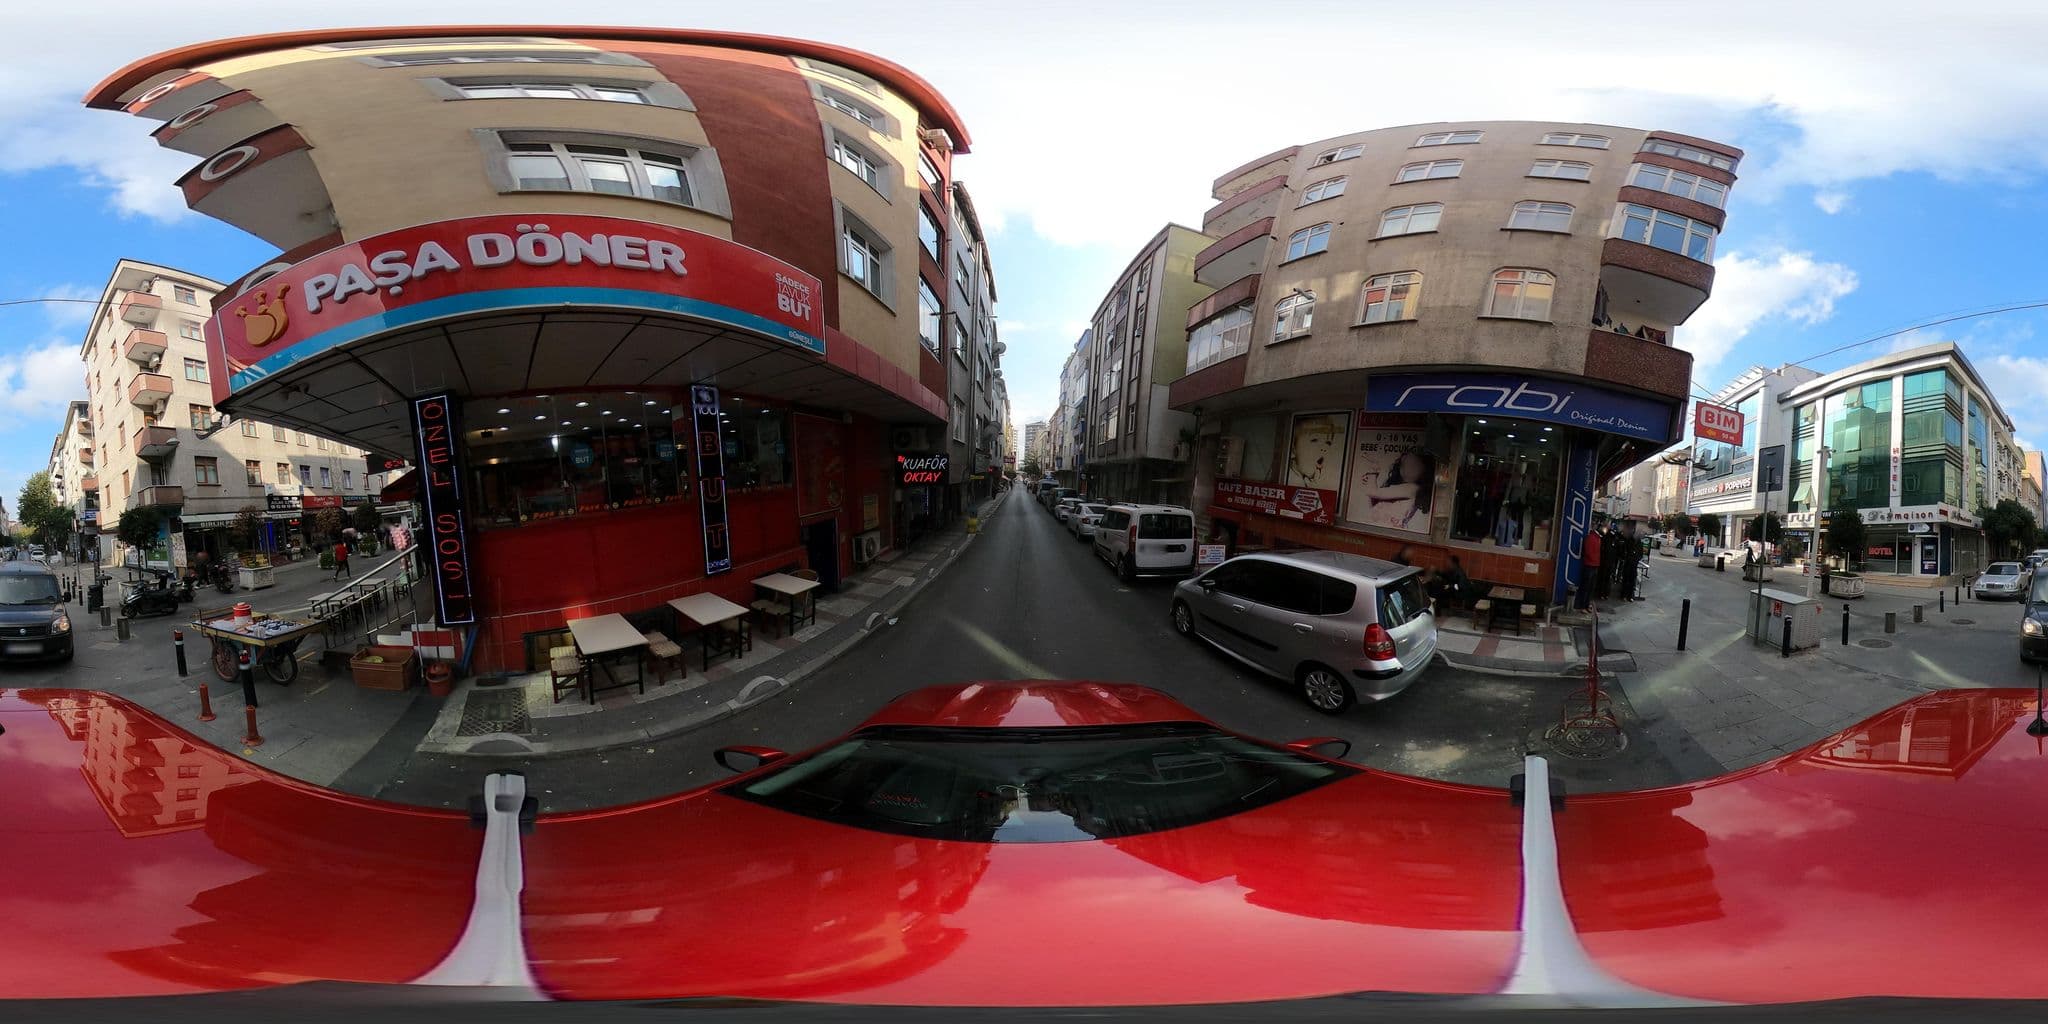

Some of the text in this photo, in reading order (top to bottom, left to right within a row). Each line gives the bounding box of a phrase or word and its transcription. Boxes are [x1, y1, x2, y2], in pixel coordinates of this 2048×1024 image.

[303, 223, 688, 313] PAŞA DÖNER
[775, 272, 809, 294] SADECE
[778, 293, 811, 321] BUT
[1395, 382, 1575, 414] rabi
[1571, 410, 1615, 426] Original
[422, 403, 450, 487] ÖZEL
[575, 456, 590, 464] BUT
[902, 454, 948, 470] KUAFÖR
[903, 471, 942, 483] OKTAY
[1218, 482, 1286, 500] CAFE BAŞER
